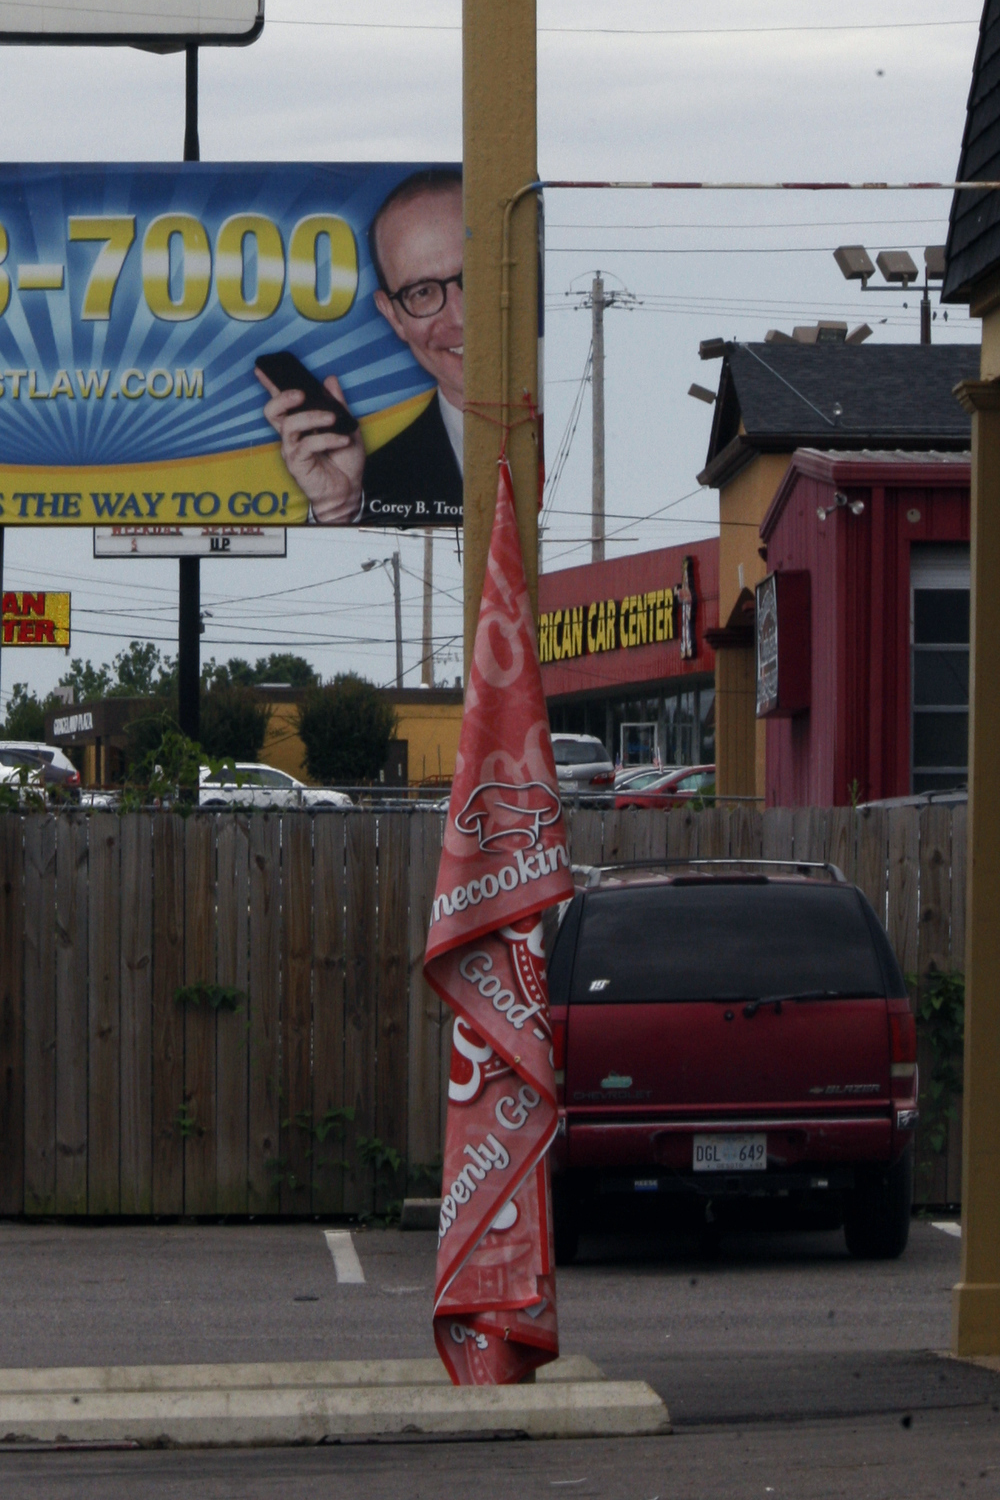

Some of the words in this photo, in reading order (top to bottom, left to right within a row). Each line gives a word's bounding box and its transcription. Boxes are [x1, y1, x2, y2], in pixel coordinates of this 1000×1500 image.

[12, 492, 82, 517] THE
[89, 492, 165, 518] WAY
[171, 491, 221, 517] TO
[228, 491, 290, 517] GO!
[369, 499, 412, 518] Corey
[415, 501, 430, 514] B.
[433, 501, 464, 515] Trot
[538, 606, 583, 663] RICAN
[587, 599, 616, 653] CAR
[620, 588, 673, 648] CENTER
[429, 843, 570, 928] mecookin
[459, 951, 541, 1030] Good
[573, 1090, 653, 1100] CHEVROLET
[824, 1083, 881, 1094] BLAZER
[696, 1145, 721, 1162] DGL
[739, 1143, 764, 1161] 649
[437, 1132, 510, 1248] avenly
[495, 1085, 541, 1130] Go
